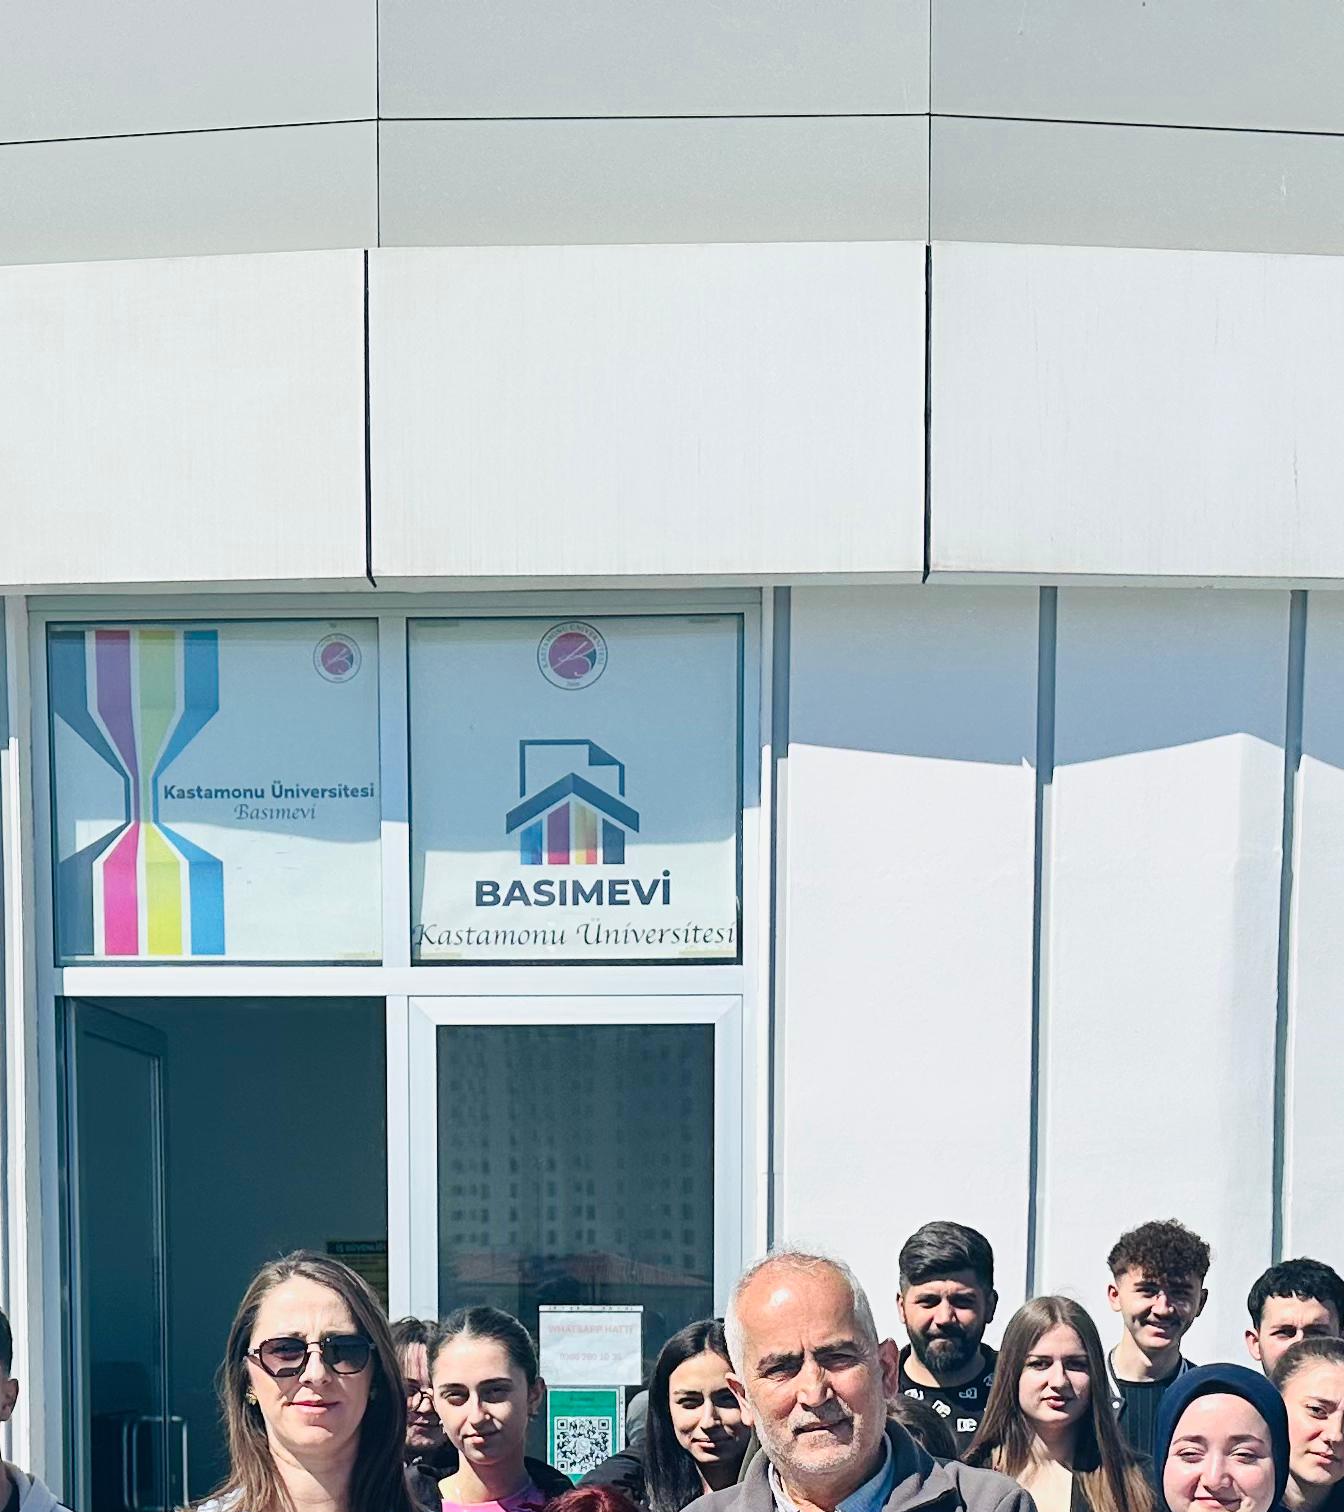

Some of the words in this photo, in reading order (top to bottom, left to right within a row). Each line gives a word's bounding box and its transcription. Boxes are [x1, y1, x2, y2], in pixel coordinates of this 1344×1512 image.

[164, 785, 265, 800] Kastamonu
[271, 780, 375, 798] Üniversitesi
[233, 803, 317, 820] Basımevi
[474, 869, 671, 907] BASIMEVİ
[413, 922, 565, 946] Kastamonu
[575, 917, 736, 946] Üniversitesi
